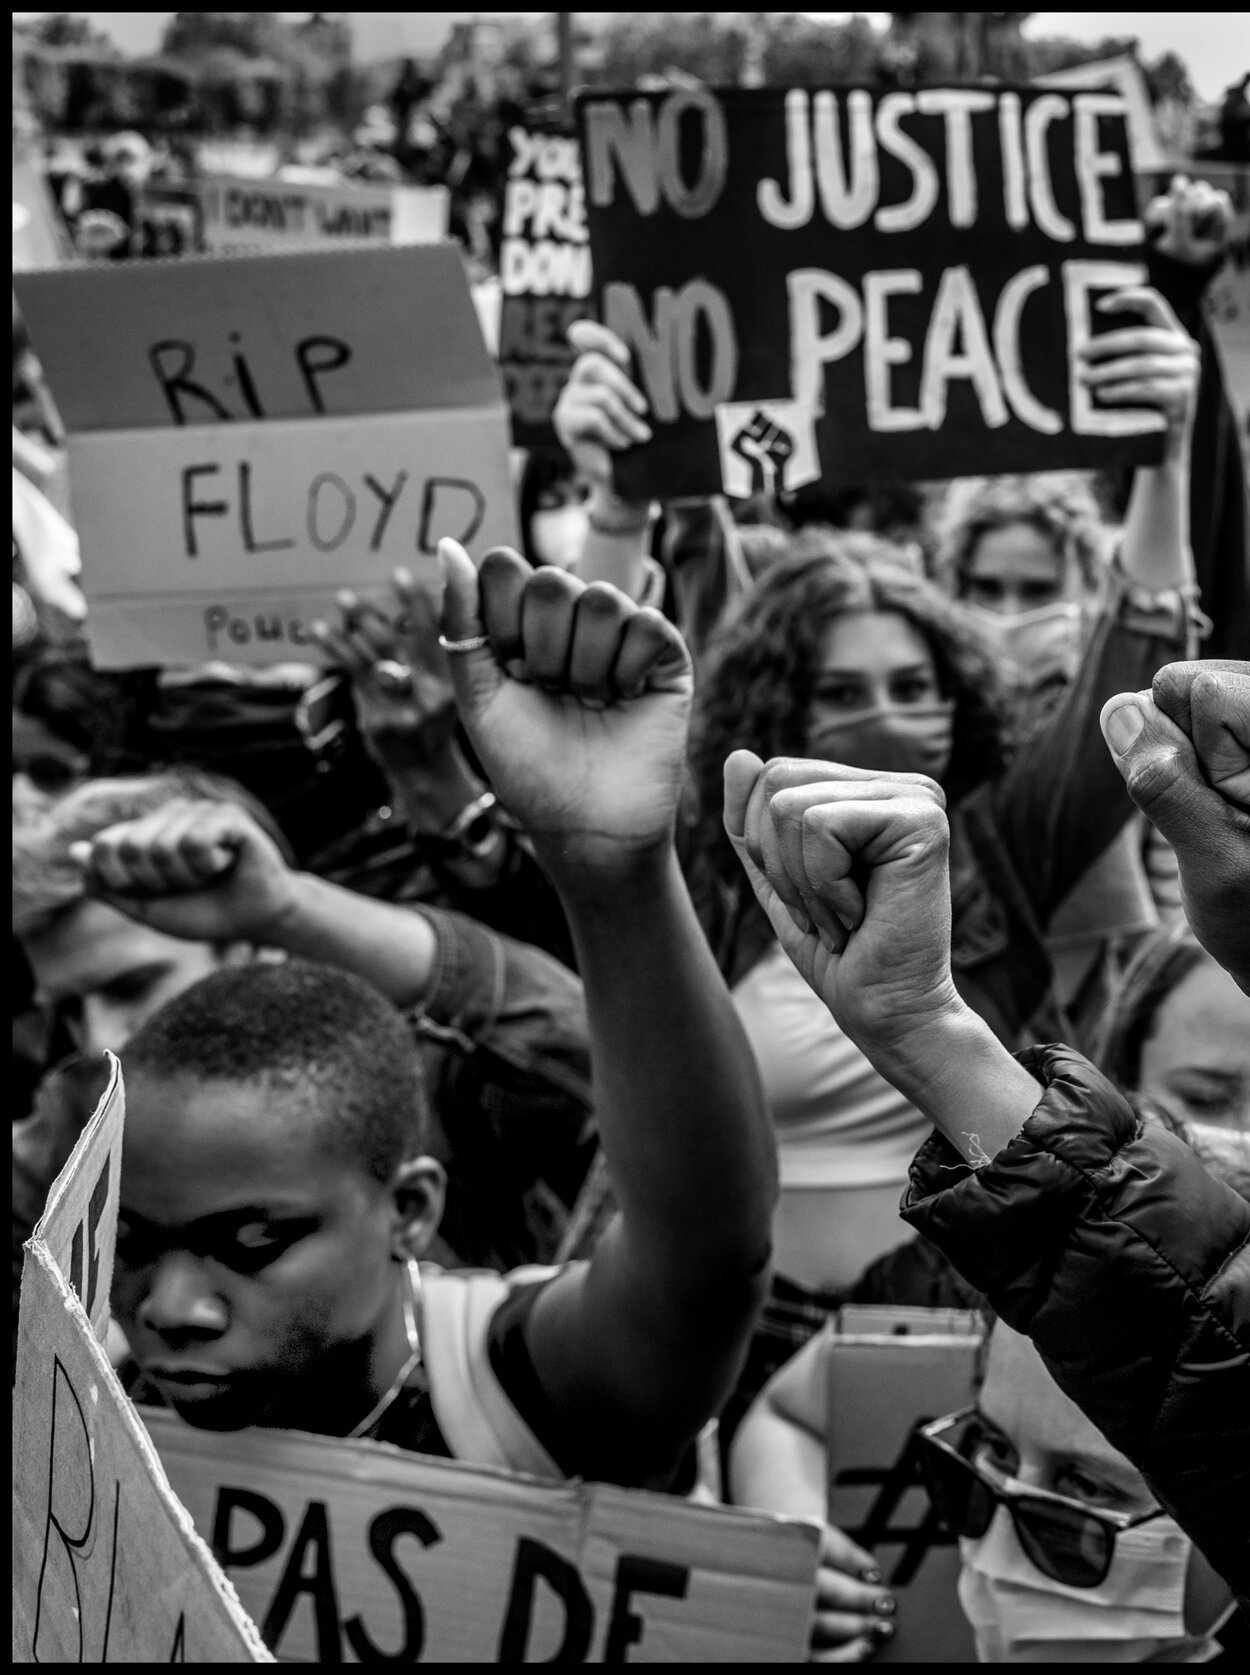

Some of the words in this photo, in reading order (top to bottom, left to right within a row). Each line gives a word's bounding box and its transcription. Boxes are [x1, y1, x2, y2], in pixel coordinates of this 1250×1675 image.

[584, 87, 727, 218] NO
[756, 88, 1146, 246] JUSTICE
[603, 279, 738, 422] NO
[786, 259, 1170, 436] PEACE
[181, 459, 487, 559] FLOYD
[210, 1485, 443, 1664] PAS
